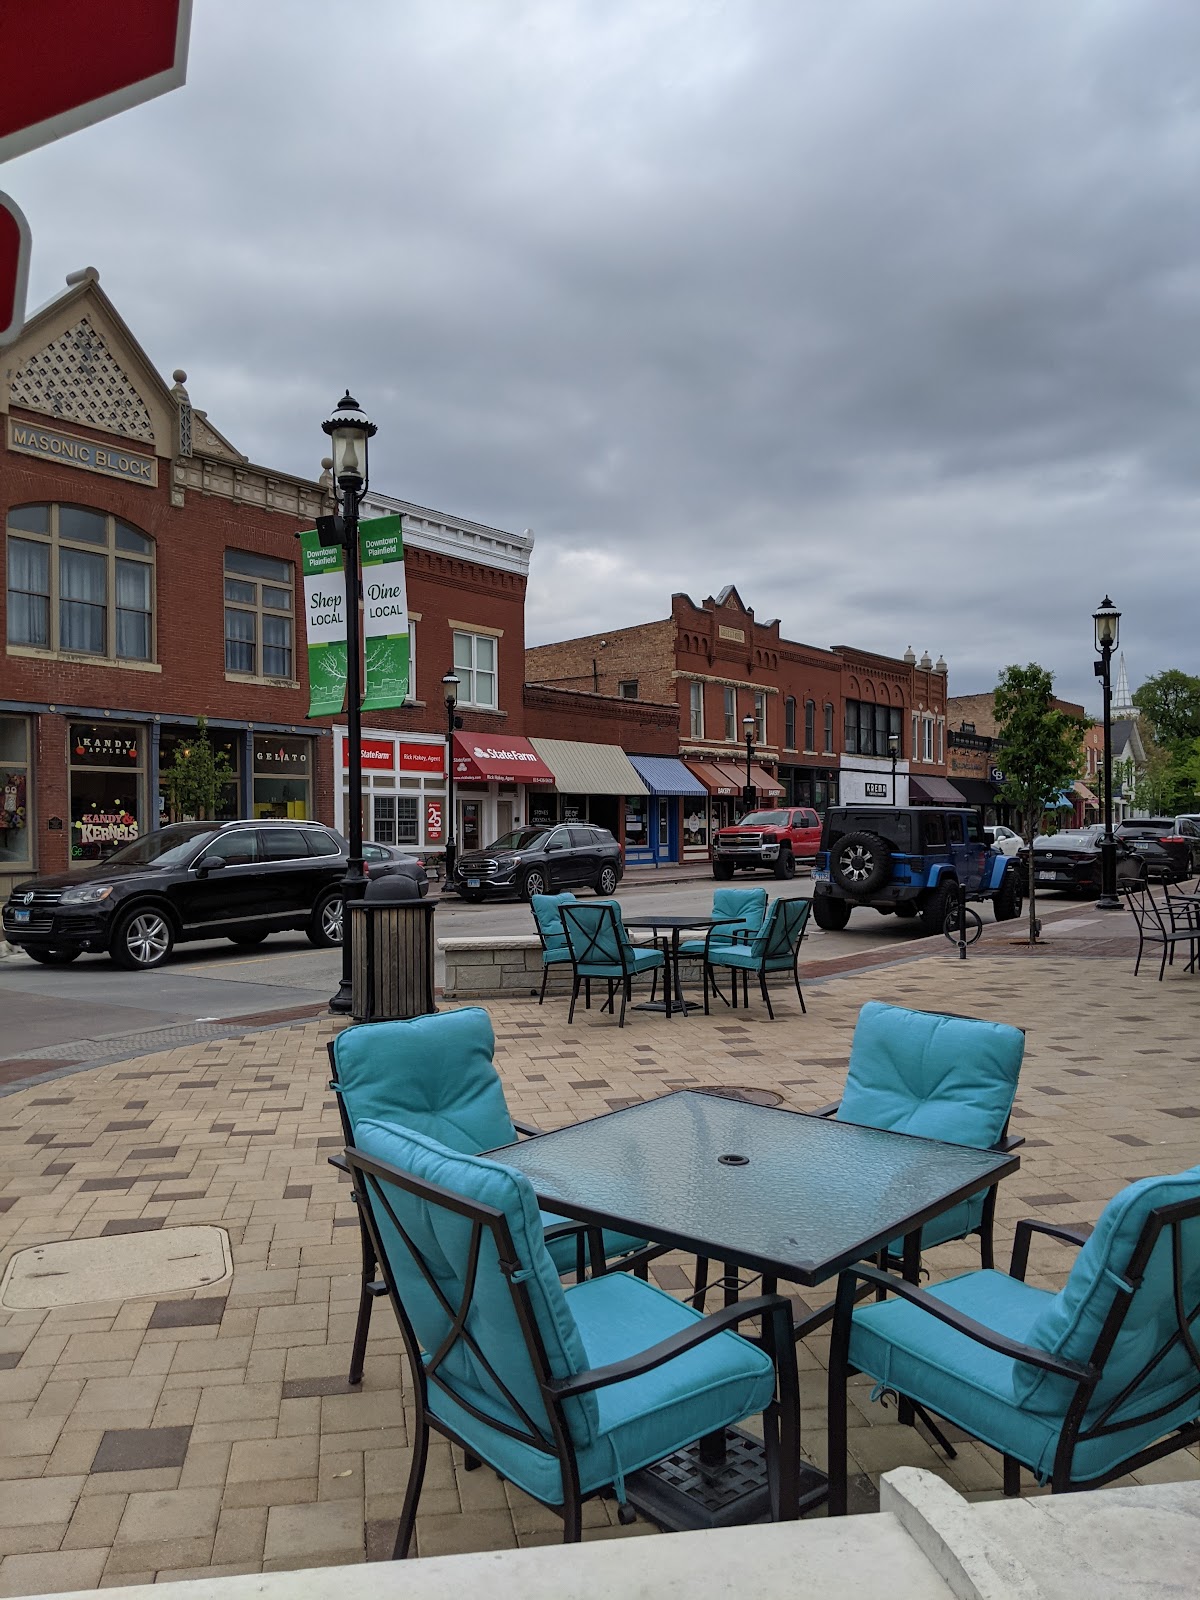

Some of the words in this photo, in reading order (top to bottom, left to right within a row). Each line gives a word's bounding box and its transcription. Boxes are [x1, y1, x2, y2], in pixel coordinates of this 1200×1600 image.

[13, 428, 90, 461] MASONIC
[95, 451, 151, 478] BLOCK
[365, 537, 398, 548] Downtown
[306, 547, 338, 558] Downtown
[368, 545, 397, 557] Plainfield
[309, 555, 337, 567] Plainfield
[367, 584, 401, 601] Dine
[310, 592, 342, 613] Shop
[369, 605, 403, 619] LOCAL
[311, 613, 344, 626] LOCAL
[83, 738, 133, 749] KANDY
[88, 747, 127, 755] APPLES
[256, 752, 307, 762] GELATO
[427, 755, 441, 763] Agent
[82, 813, 123, 824] KANDY
[121, 812, 135, 825] &
[428, 808, 442, 827] 25
[80, 823, 139, 843] KERNELS
